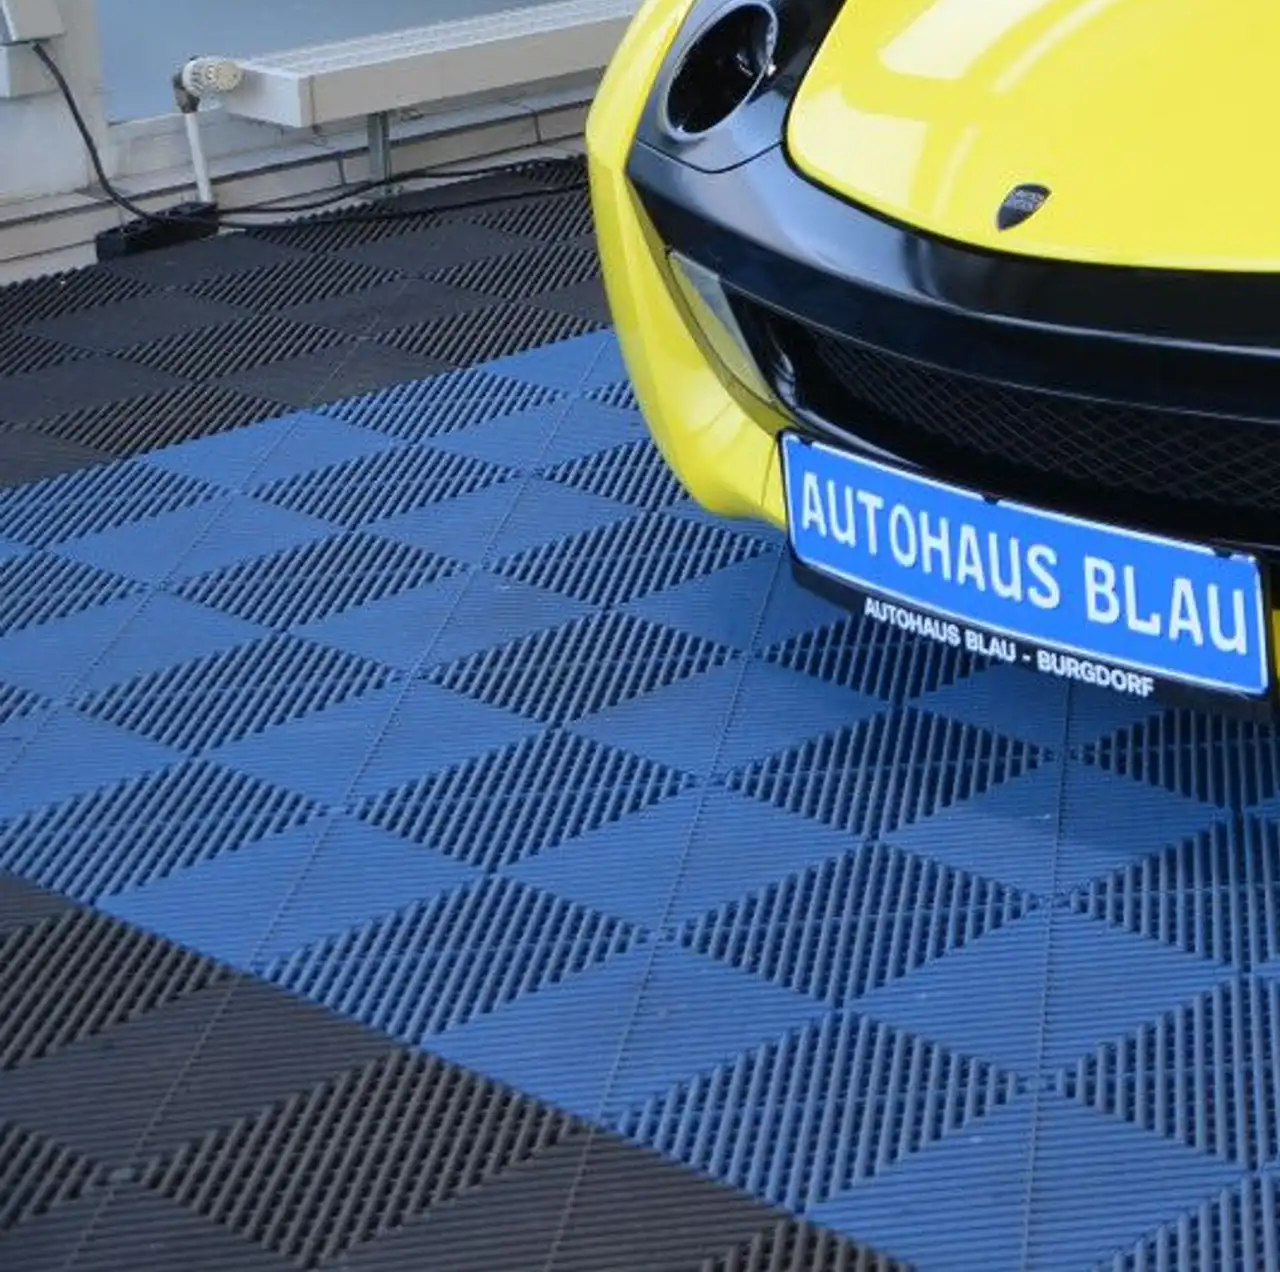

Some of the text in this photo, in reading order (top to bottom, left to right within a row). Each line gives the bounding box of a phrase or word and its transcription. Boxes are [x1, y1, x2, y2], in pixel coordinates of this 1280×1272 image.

[802, 470, 1247, 655] AUTOHAUS BLAU
[864, 597, 960, 647] AUTOHAUS
[965, 631, 1016, 662] BLAU
[1037, 650, 1154, 697] BURGDORF
